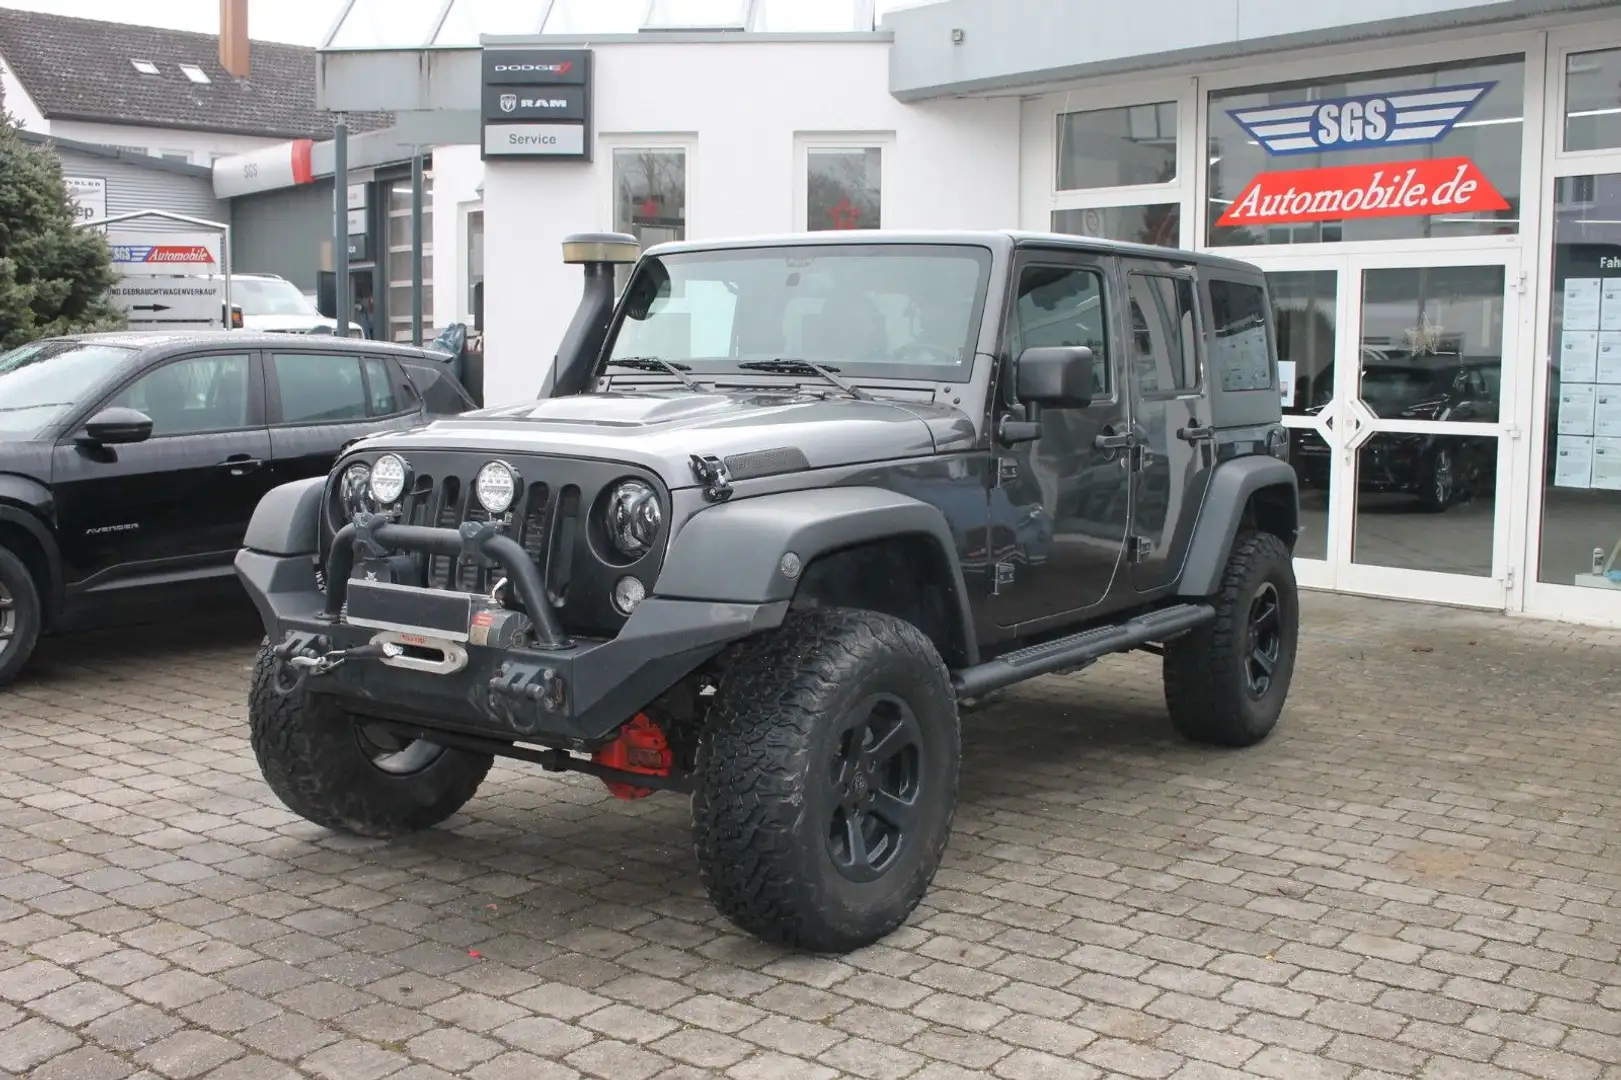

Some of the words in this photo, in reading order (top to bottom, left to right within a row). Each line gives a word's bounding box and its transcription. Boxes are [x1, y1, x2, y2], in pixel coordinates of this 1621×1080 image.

[495, 64, 563, 72] DODGE
[521, 99, 567, 108] RAM
[1317, 99, 1387, 145] SGS
[509, 133, 557, 145] Service
[244, 163, 259, 179] SGS
[1229, 164, 1478, 218] Automobile.de
[114, 247, 131, 260] SGS
[149, 247, 208, 261] Automobile
[1600, 256, 1621, 269] Fah
[122, 288, 217, 296] GEBRAUCHTWAGENVERKAUF
[86, 523, 139, 535] AVENGER
